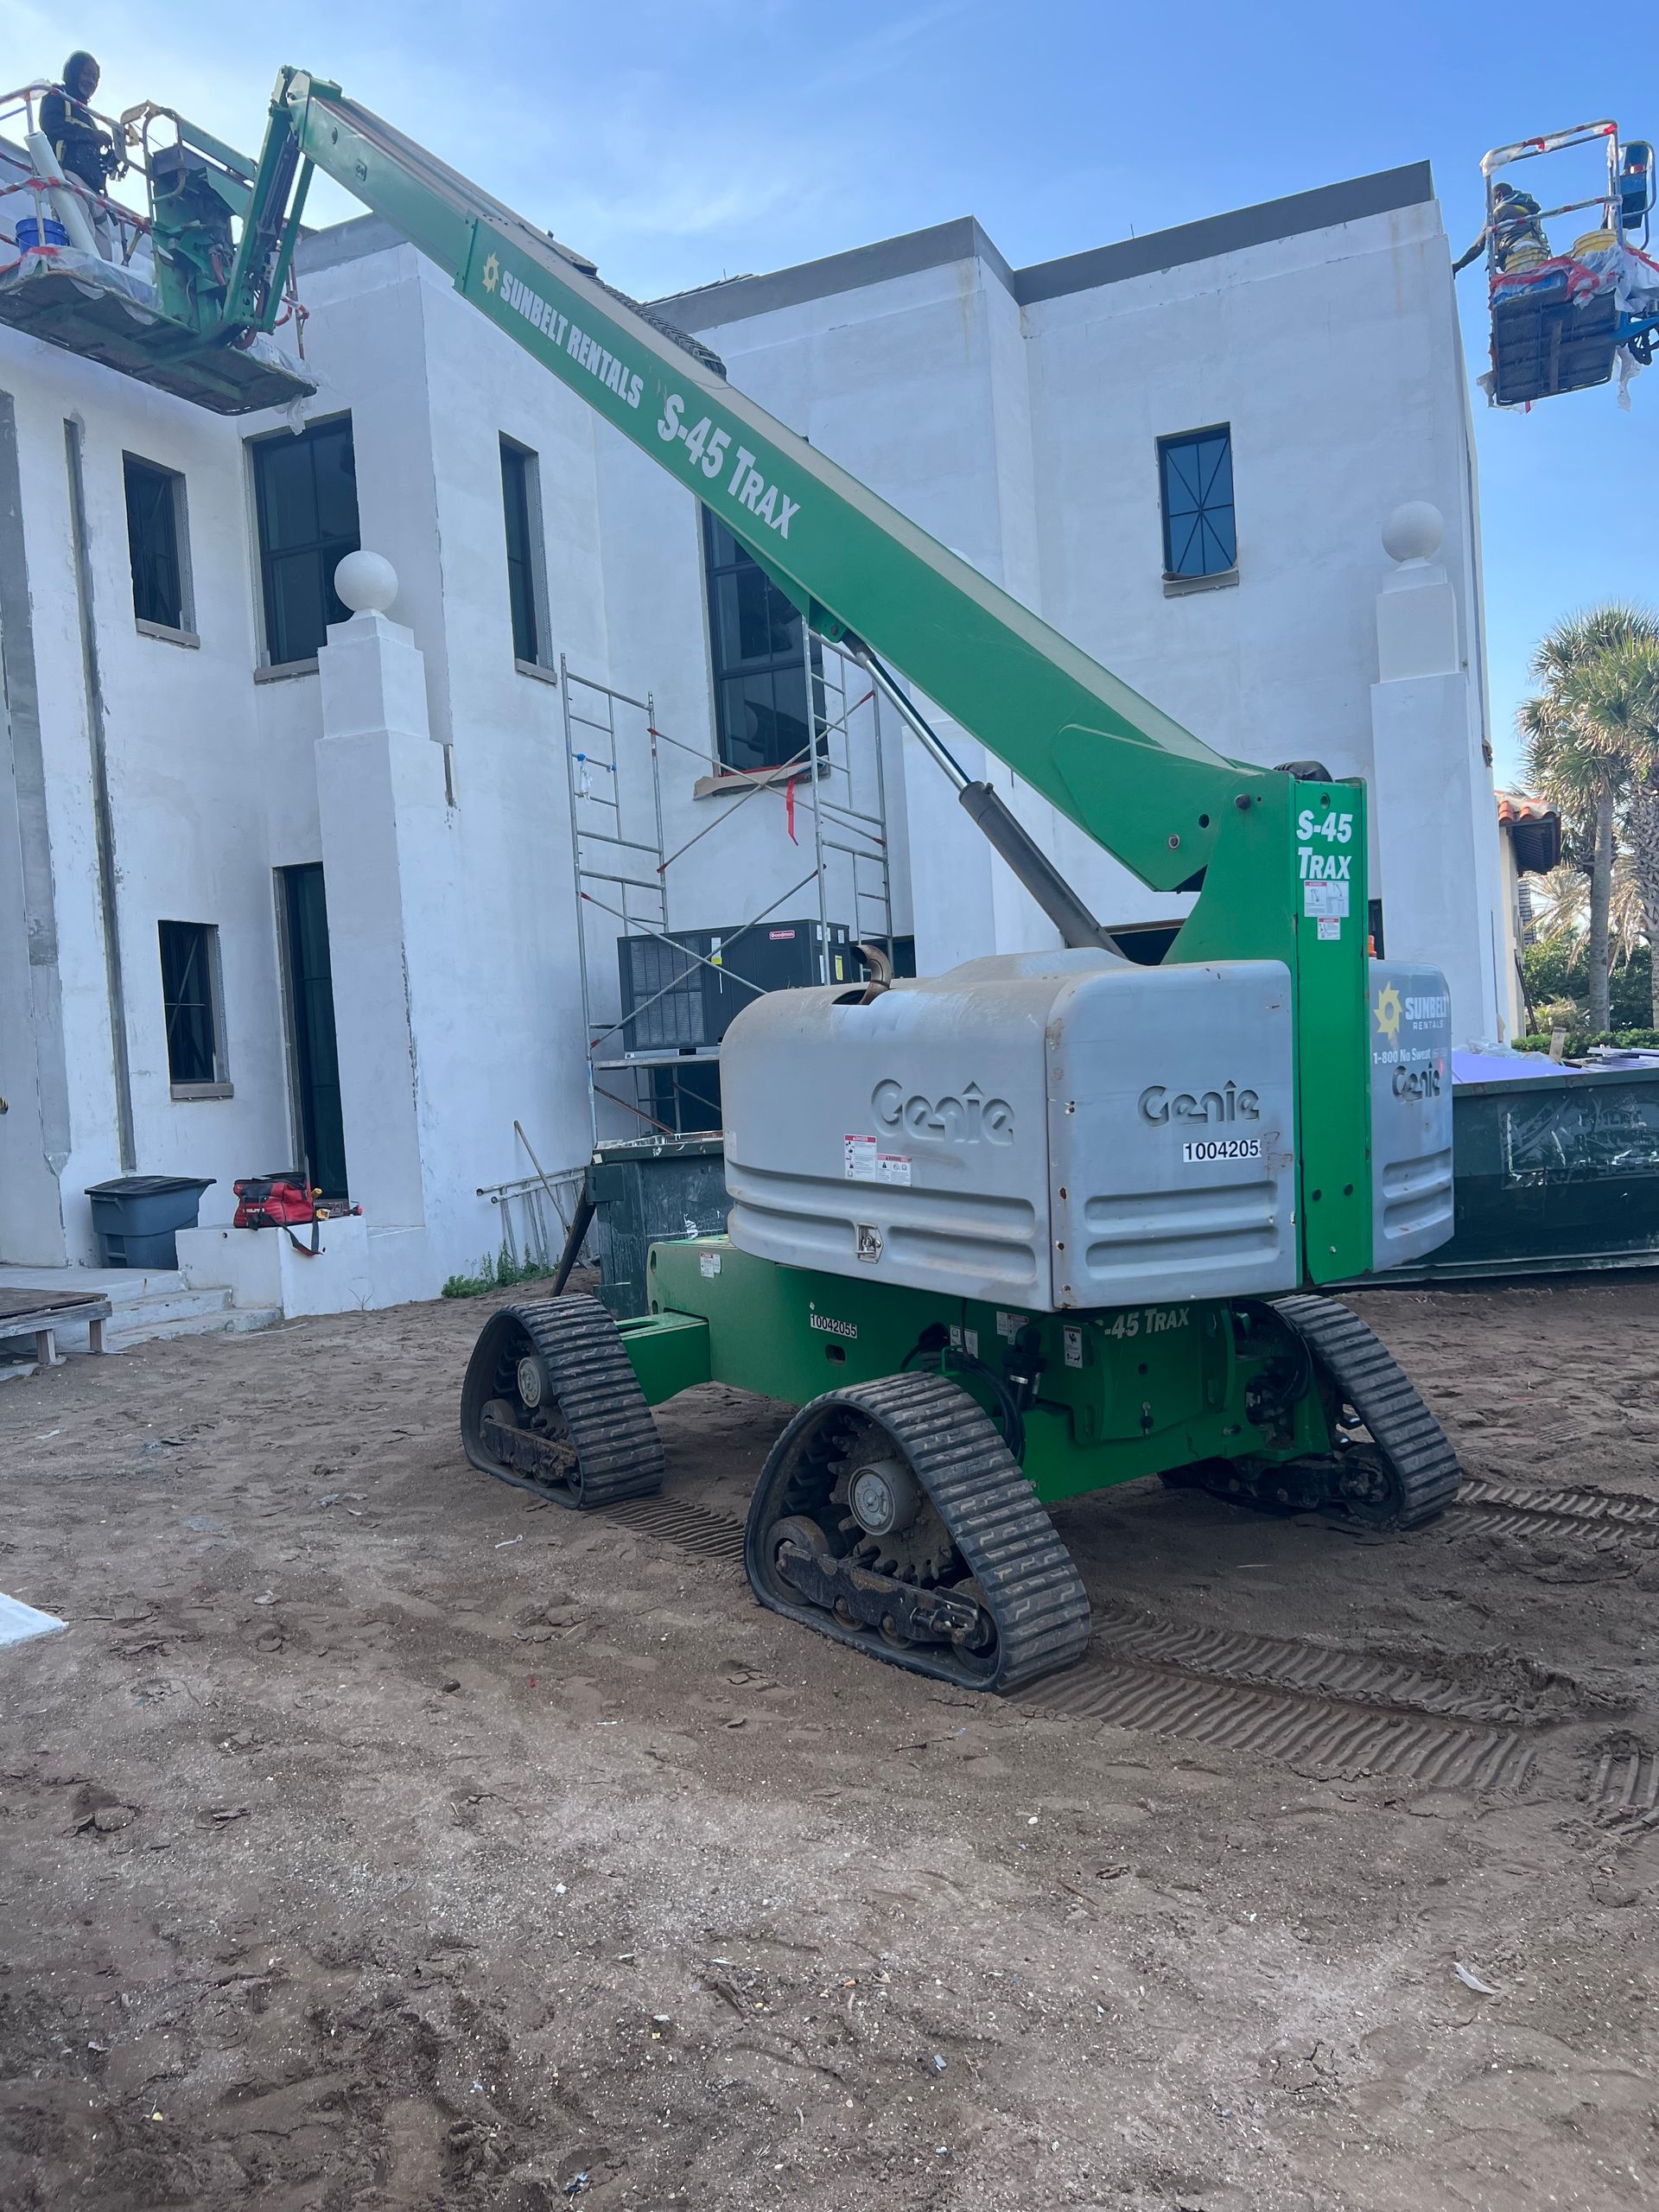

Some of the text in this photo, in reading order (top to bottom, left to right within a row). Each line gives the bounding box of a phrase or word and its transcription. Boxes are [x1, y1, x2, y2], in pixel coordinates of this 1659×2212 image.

[500, 270, 645, 409] SUNBELT RENTALS
[657, 394, 801, 539] S-45 TRAX
[1296, 810, 1353, 843] S-45
[1298, 847, 1351, 880] TRAX
[1405, 995, 1446, 1020] SUNBELT
[1413, 1020, 1444, 1030] RENTALS
[1373, 1051, 1398, 1065] 1-800
[1400, 1049, 1411, 1062] No
[1412, 1047, 1432, 1061] Sweat
[1392, 1061, 1441, 1103] Genie
[871, 1078, 1015, 1147] Genie
[1137, 1079, 1260, 1128] Genie
[810, 1313, 857, 1338] 10042055
[1094, 1306, 1190, 1339] -45 TRAX
